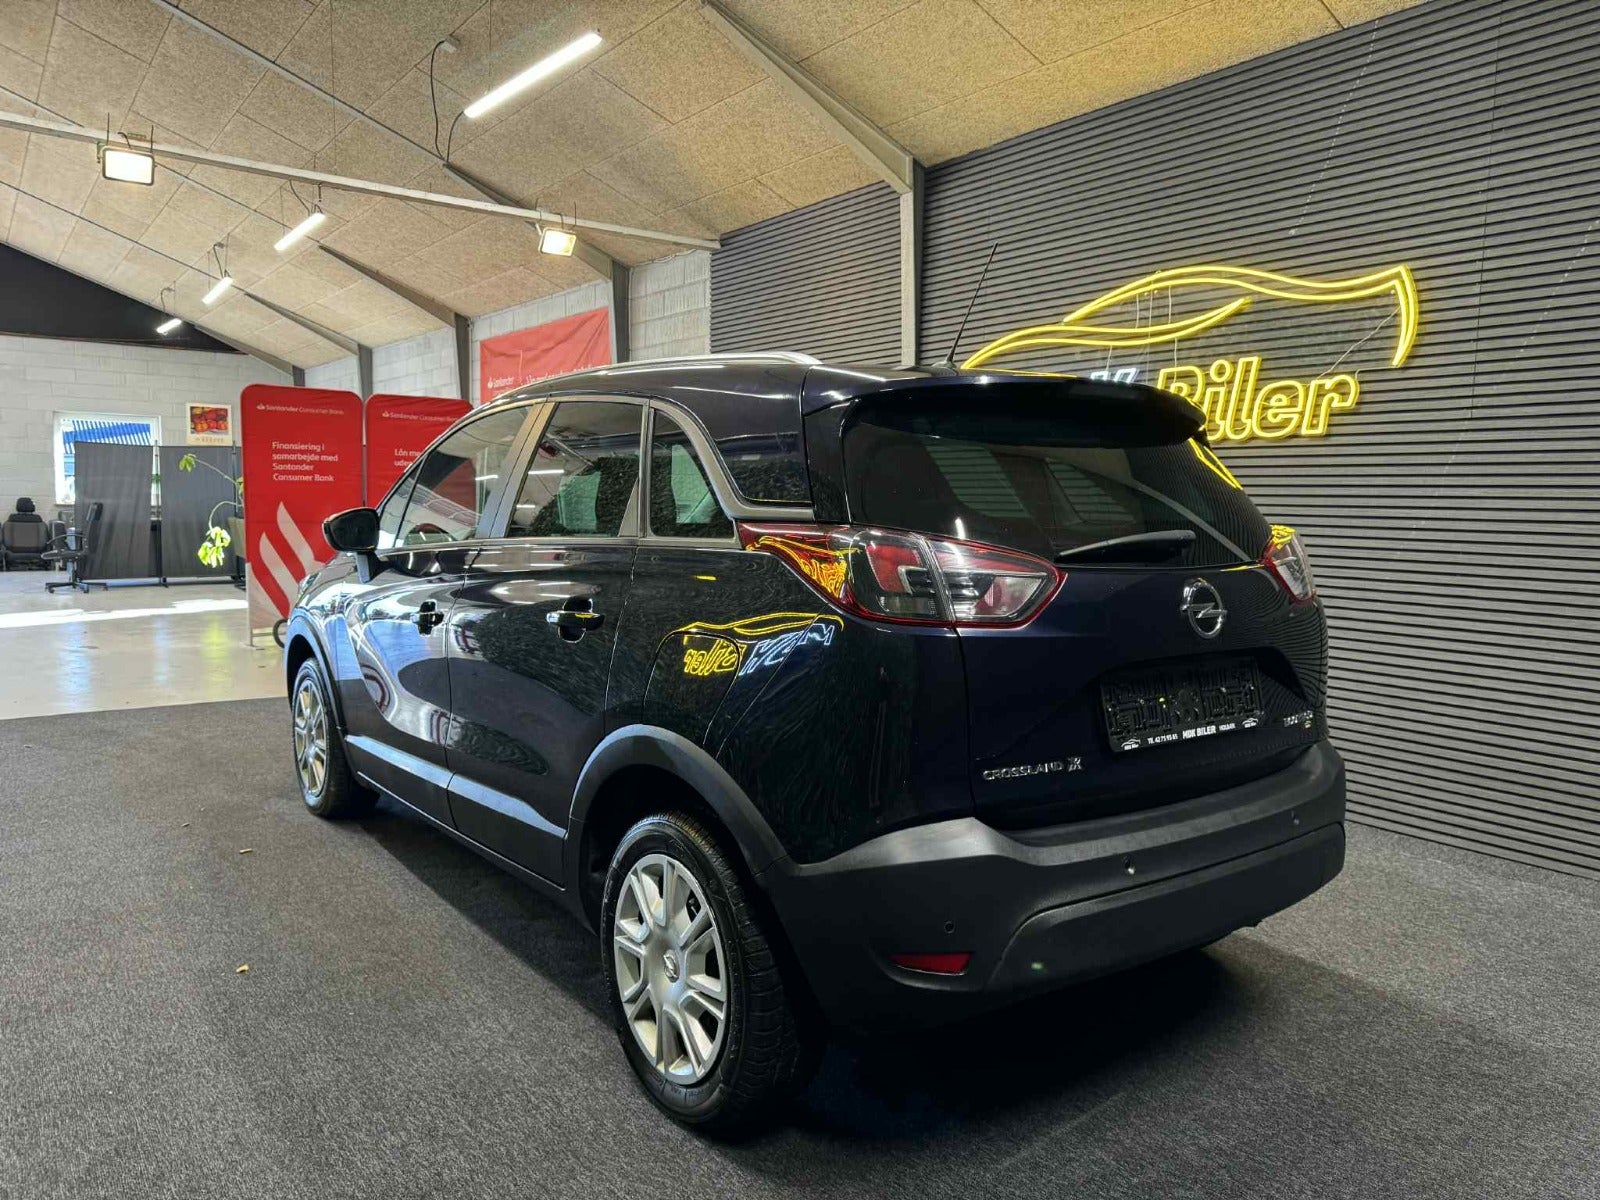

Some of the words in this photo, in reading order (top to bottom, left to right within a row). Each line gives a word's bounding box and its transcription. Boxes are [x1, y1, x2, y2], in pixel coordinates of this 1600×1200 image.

[272, 441, 321, 452] Finansiering
[272, 453, 320, 462] samarbejde
[321, 454, 339, 462] med
[394, 449, 408, 457] Lån
[272, 462, 314, 471] Santander
[273, 472, 313, 481] Consumer
[314, 474, 335, 482] Bank
[1196, 725, 1217, 737] BILER
[983, 761, 1063, 780] CROSSLAND
